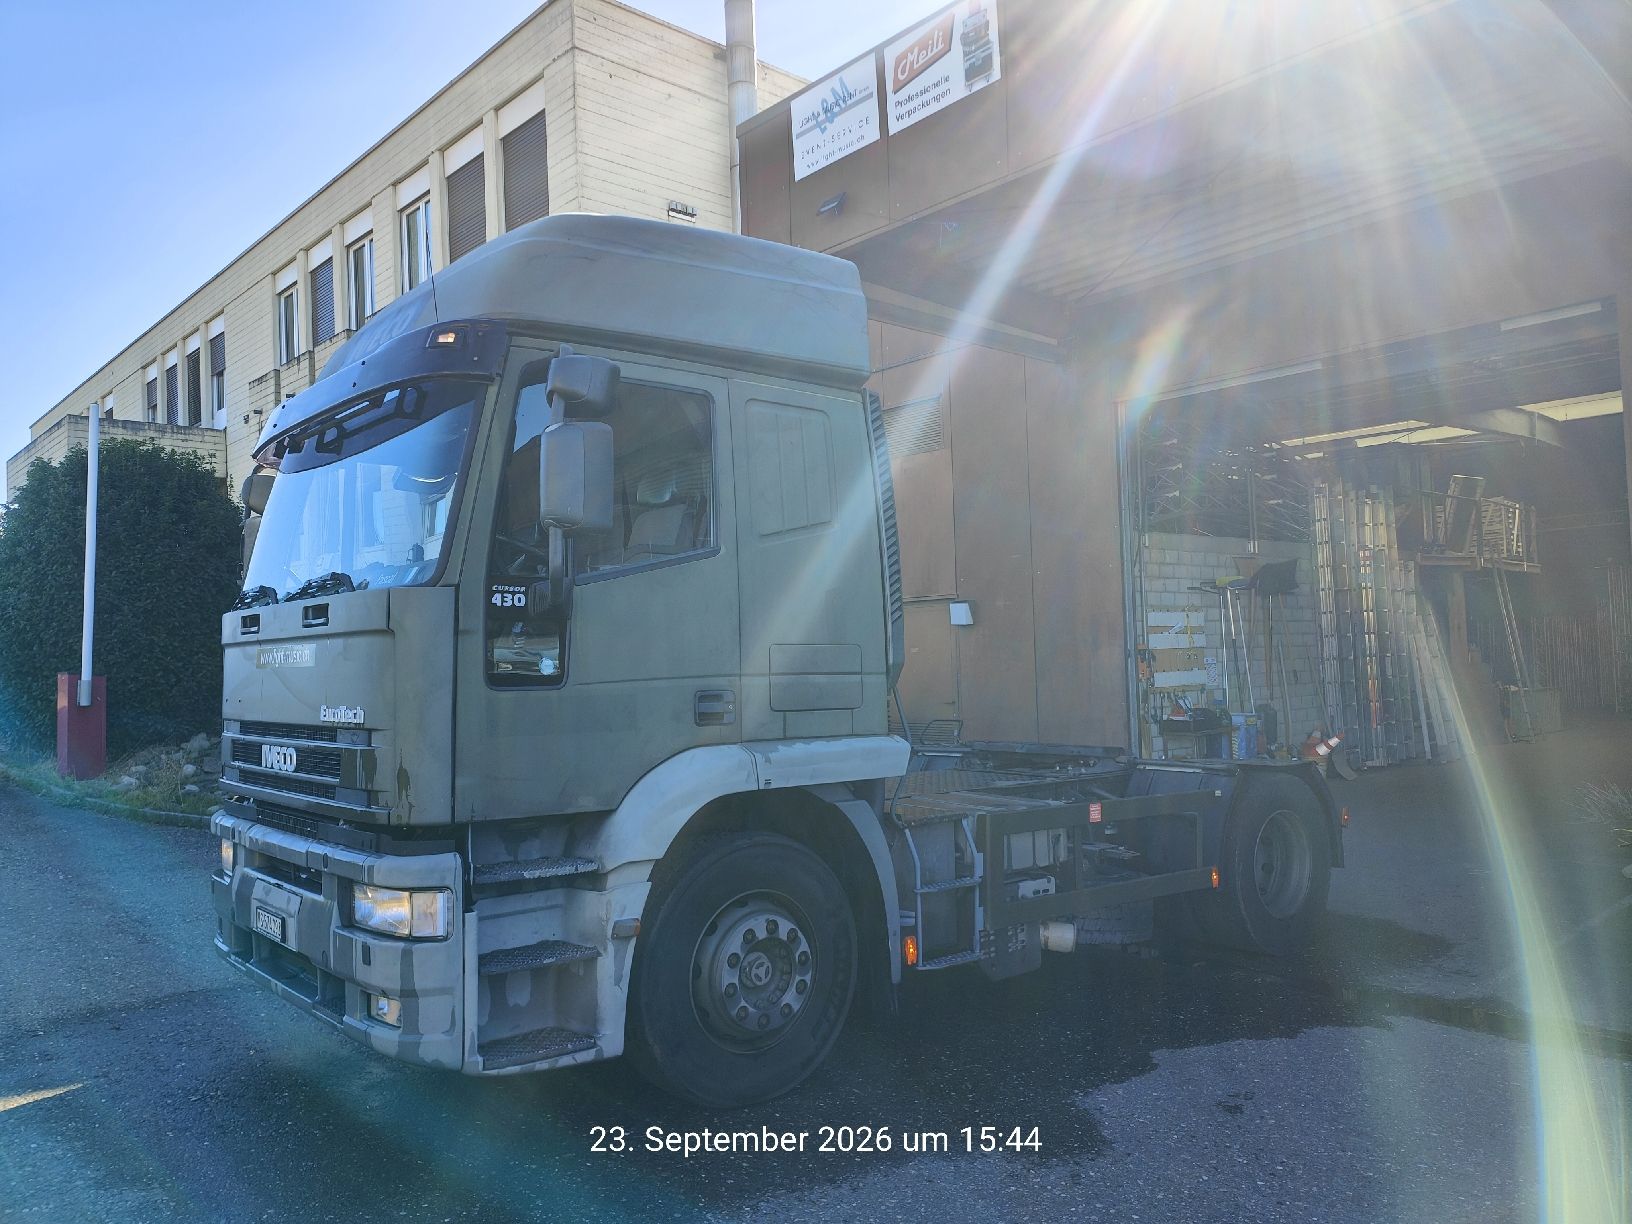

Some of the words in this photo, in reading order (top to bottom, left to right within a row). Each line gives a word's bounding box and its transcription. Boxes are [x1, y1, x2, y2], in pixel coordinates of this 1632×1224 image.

[897, 30, 945, 80] Meili
[894, 74, 950, 109] Professionelle
[895, 88, 951, 122] Verpackungen
[491, 584, 526, 592] CURSOR
[491, 592, 526, 607] 430
[320, 704, 365, 724] EuroTech
[261, 744, 297, 772] IVECO
